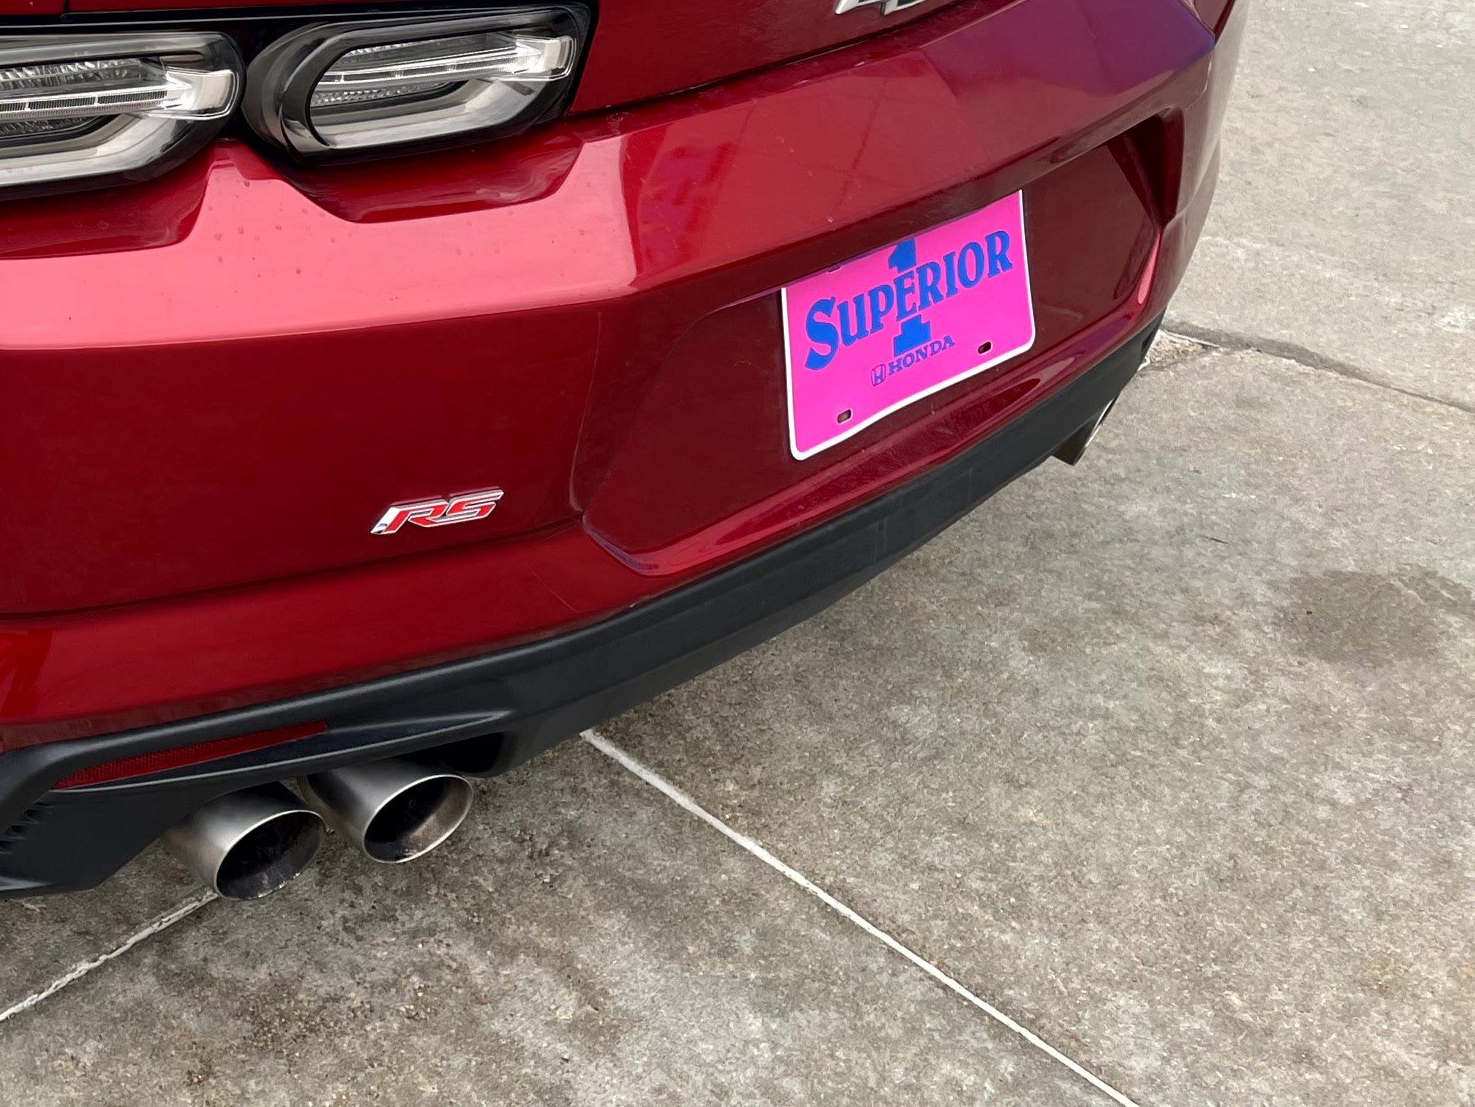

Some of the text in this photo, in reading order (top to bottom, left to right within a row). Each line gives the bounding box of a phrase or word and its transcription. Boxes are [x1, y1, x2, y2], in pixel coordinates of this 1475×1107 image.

[804, 230, 1013, 371] SUPERIOR
[888, 335, 956, 376] HONDA
[370, 489, 505, 535] RS
